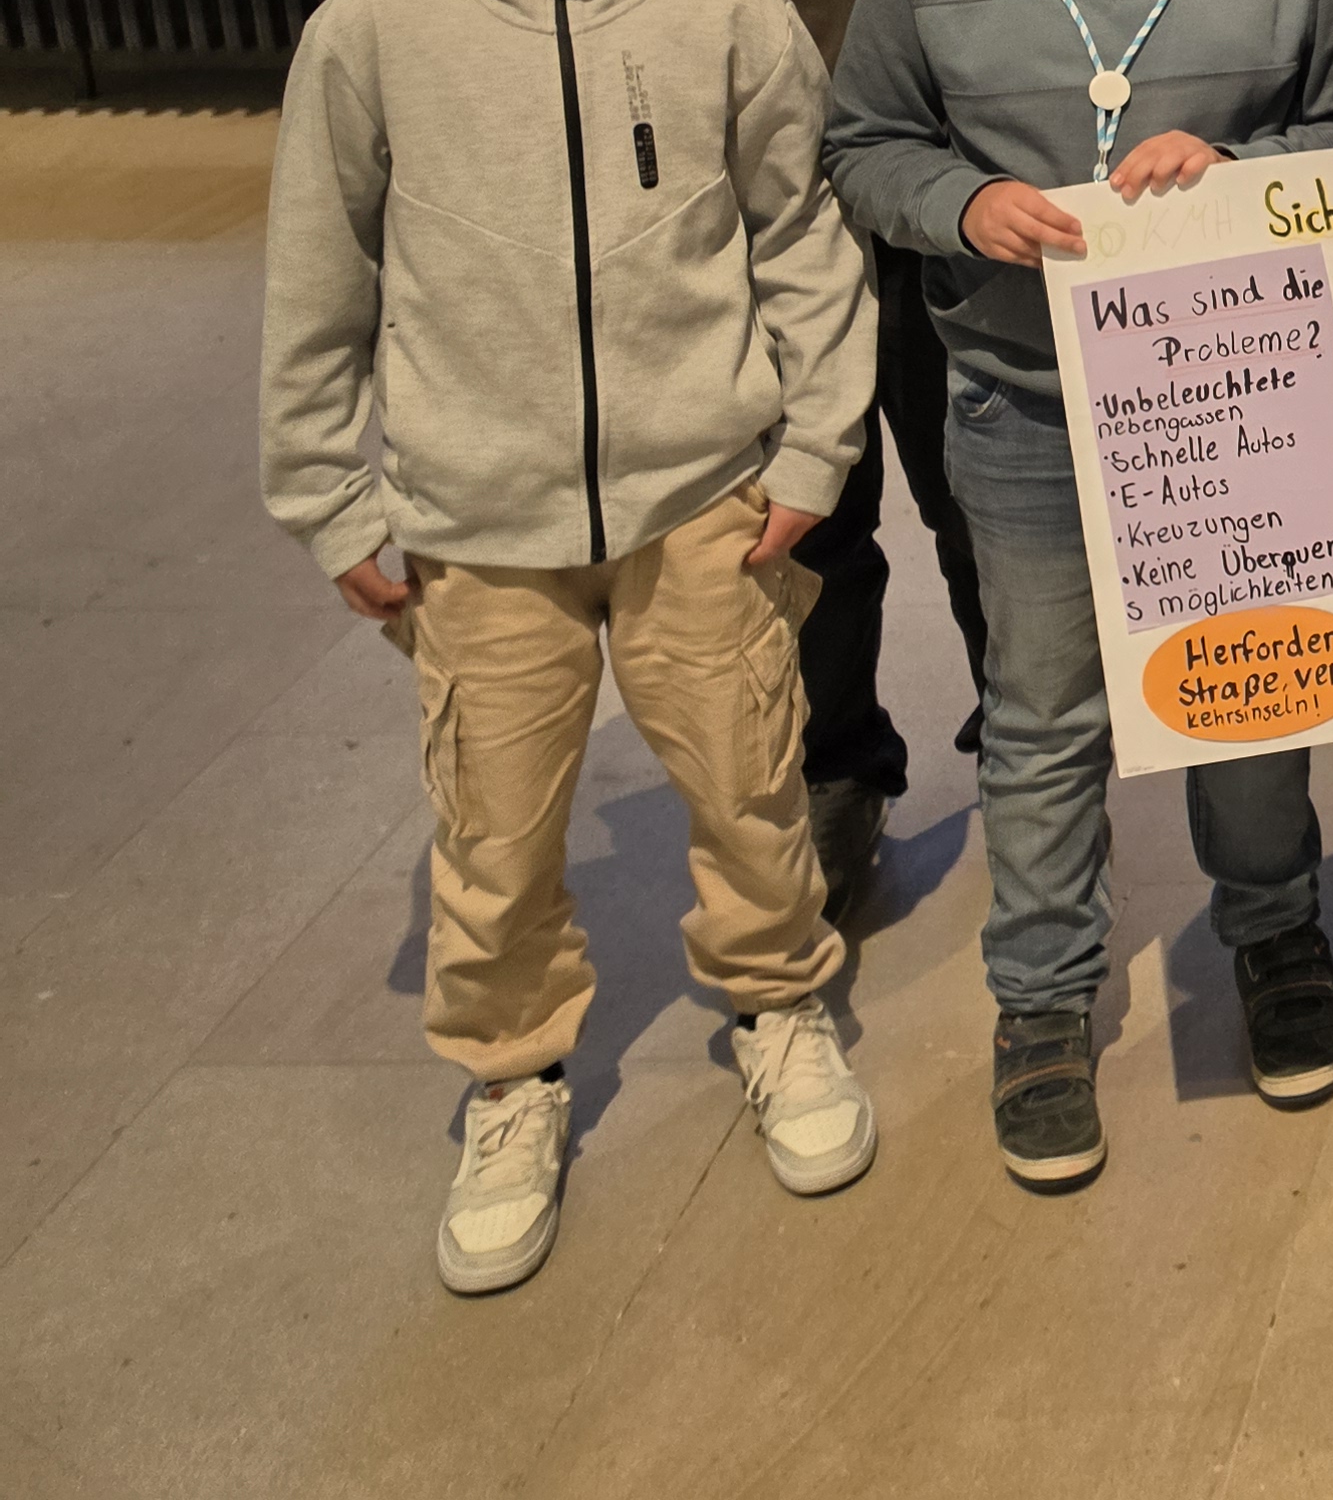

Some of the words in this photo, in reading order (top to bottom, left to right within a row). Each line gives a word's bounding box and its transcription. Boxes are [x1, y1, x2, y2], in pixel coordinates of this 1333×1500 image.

[1091, 287, 1170, 332] Was
[1192, 275, 1264, 316] sind
[1283, 267, 1325, 301] die
[1152, 320, 1323, 367] Probleme?
[1102, 367, 1297, 420] Unbeleuchtete
[1097, 403, 1244, 442] nebengassen
[1111, 436, 1219, 473] Schnelle
[1237, 424, 1296, 458] Autos
[1128, 510, 1283, 548] Kreuzungen
[1132, 557, 1197, 588] Keine
[1158, 570, 1333, 617] möglichkeiten
[1187, 694, 1322, 729] kehrsinseln!
